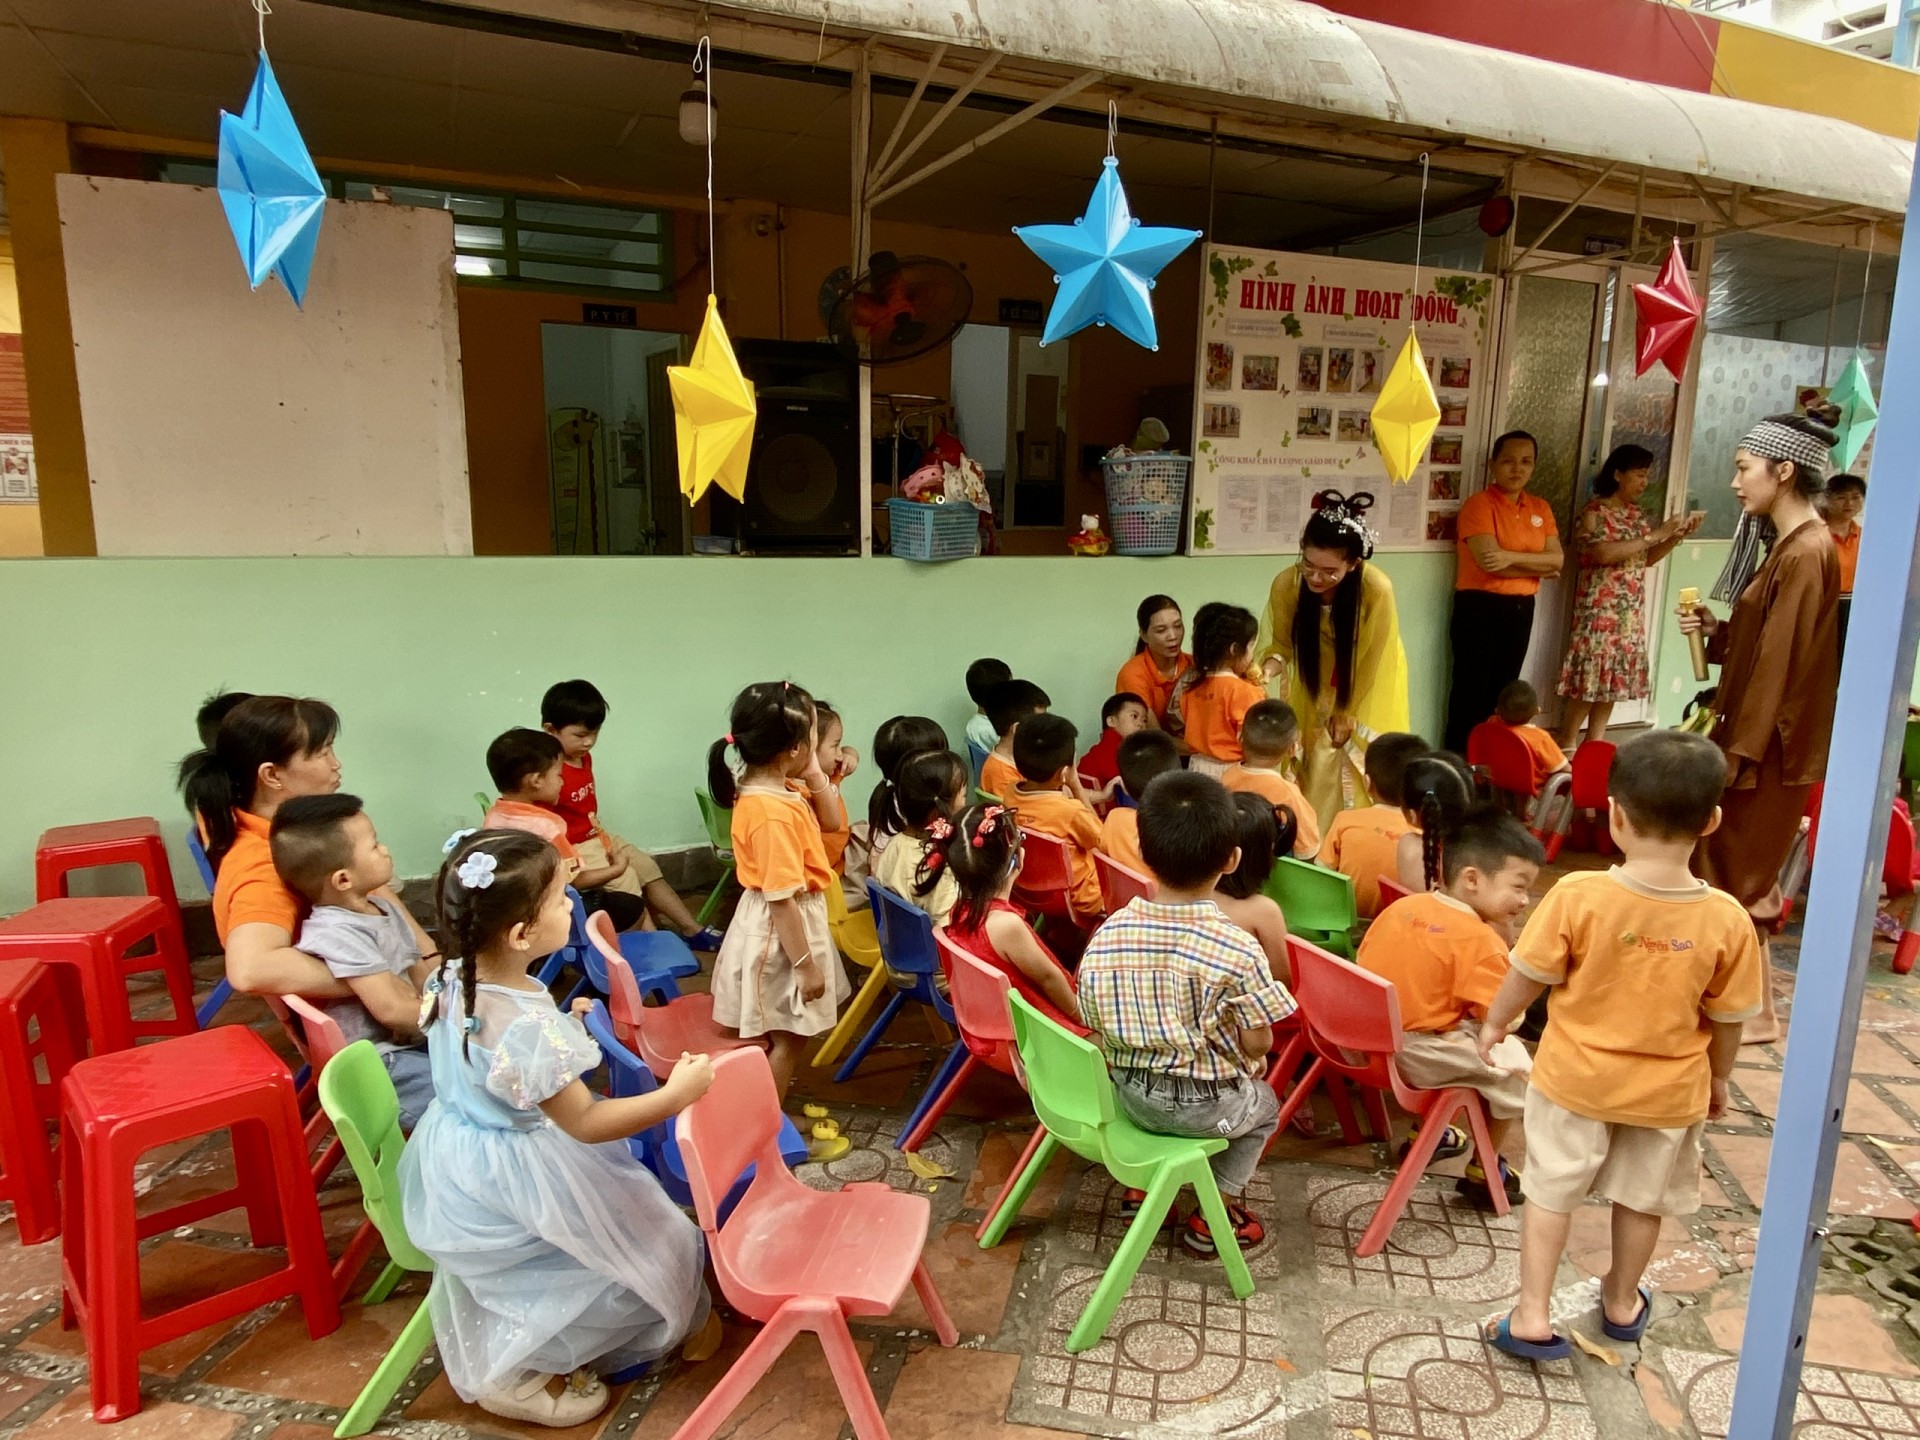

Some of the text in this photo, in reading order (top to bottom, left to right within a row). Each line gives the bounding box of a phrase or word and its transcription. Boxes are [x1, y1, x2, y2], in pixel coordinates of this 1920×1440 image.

[1239, 273, 1459, 328] HÌNH ẢNH HOẠT ĐỘNG
[1670, 938, 1694, 952] Sao
